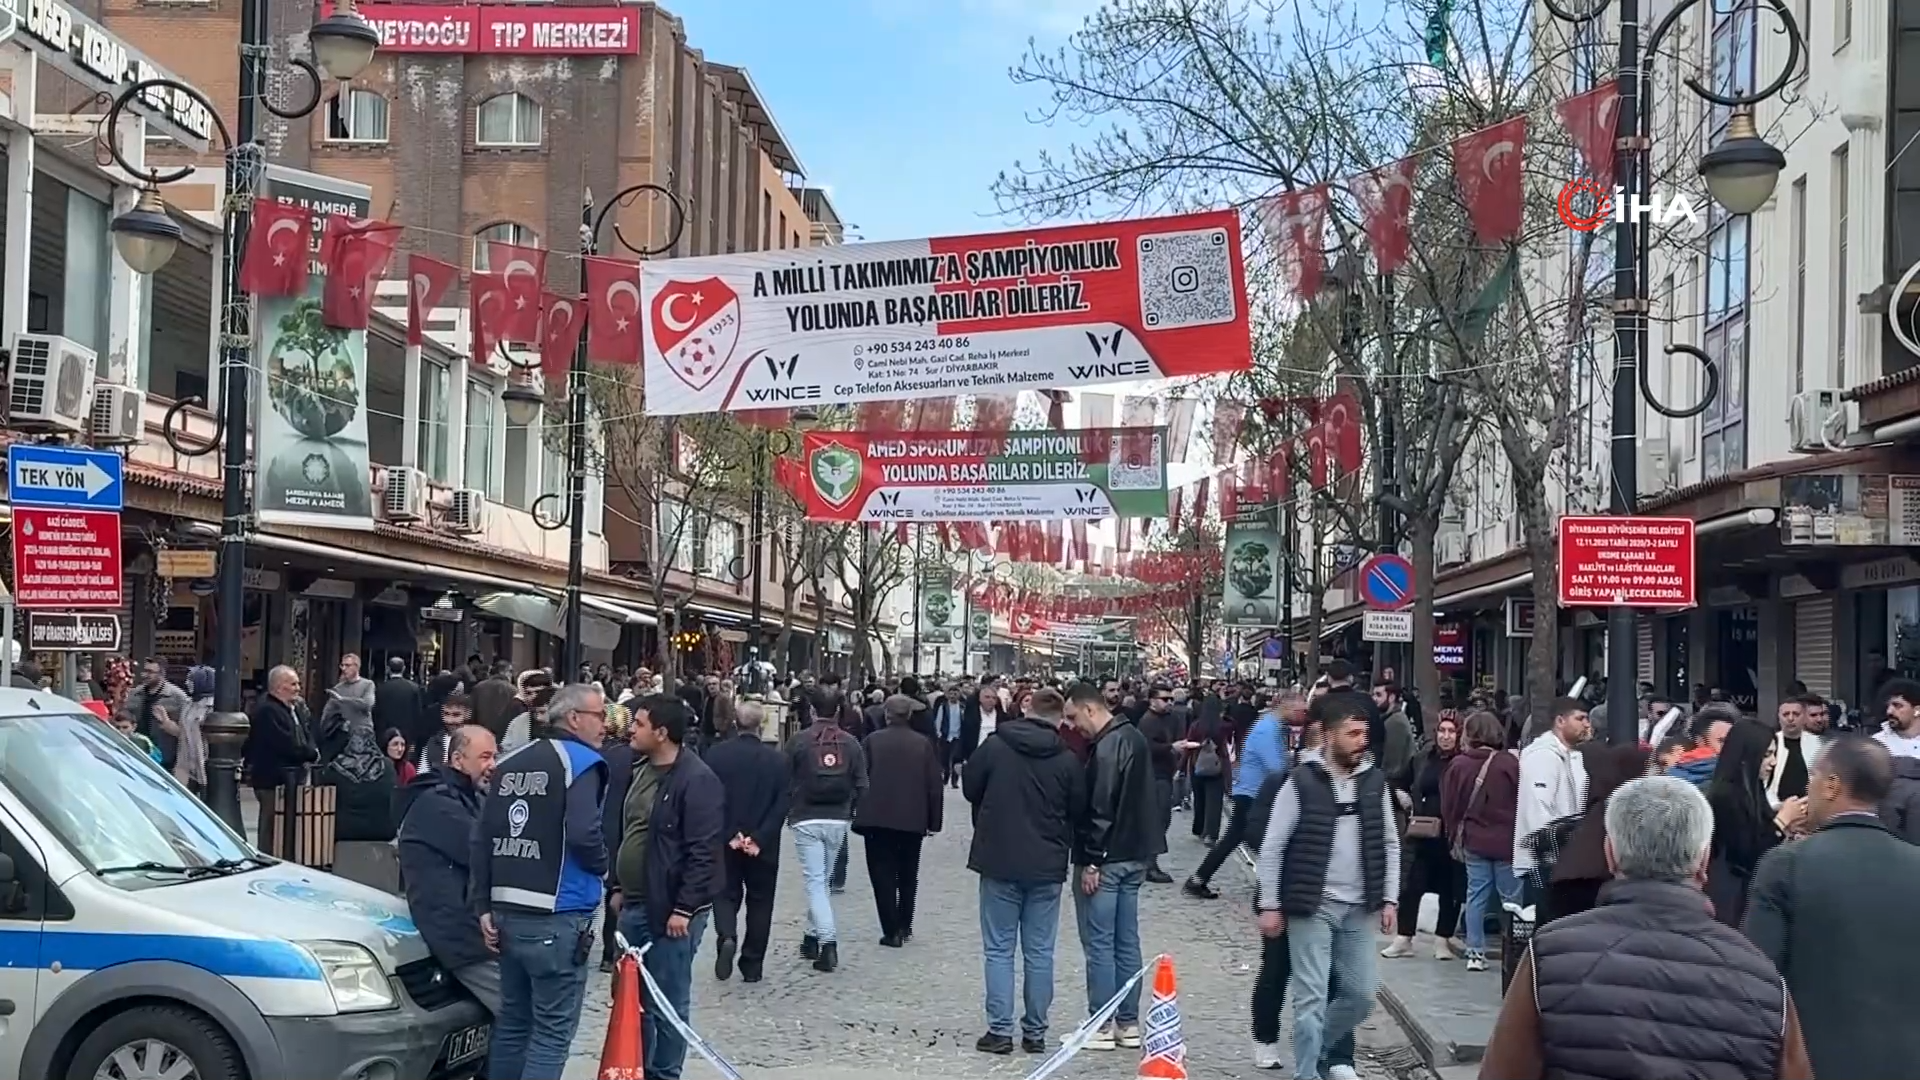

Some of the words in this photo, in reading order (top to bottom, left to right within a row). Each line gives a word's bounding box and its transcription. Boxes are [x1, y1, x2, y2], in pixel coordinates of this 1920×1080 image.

[491, 22, 526, 48] TIP
[532, 16, 628, 49] MERKEZİ
[312, 199, 357, 217] AMEDÊ
[753, 271, 769, 298] A
[773, 259, 827, 297] MİLLİ
[830, 254, 962, 293] TAKIMIMIZ'A
[966, 240, 1121, 286] ŞAMPİYONLUK
[786, 303, 881, 333] YOLUNDA
[886, 290, 1001, 326] BAŞARILAR
[1005, 274, 1089, 316] DİLERİZ.
[708, 313, 735, 336] 1923
[867, 343, 888, 355] +90
[891, 341, 912, 353] 534
[915, 339, 936, 351] 243
[938, 338, 953, 349] 40
[955, 336, 970, 347] 86
[909, 368, 919, 376] 74
[945, 361, 999, 374] DİYARBAKIR
[1068, 360, 1150, 379] WINCE
[746, 385, 821, 402] WINCE
[834, 385, 853, 398] Cep
[855, 381, 892, 395] Telefon
[894, 377, 956, 392] Aksesuarları
[957, 378, 970, 387] ve
[971, 373, 1005, 387] Teknik
[1007, 371, 1054, 384] Malzeme
[867, 440, 906, 458] AMED
[20, 467, 49, 487] TEK
[56, 466, 85, 489] YÖN
[881, 464, 947, 483] YOLUNDA
[950, 461, 1031, 484] BAŞARILAR
[1033, 458, 1090, 480] DİLERİZ.
[1063, 506, 1110, 517] WINCE
[1568, 523, 1607, 534] DİYARBAKIR
[1608, 523, 1647, 535] BÜYÜKŞEHİR
[1649, 525, 1685, 535] BELEDİYESİ
[1615, 562, 1642, 572] LOJİSTİK
[1571, 575, 1594, 584] SAAT
[1598, 575, 1620, 584] 19:00
[1621, 576, 1631, 584] ve
[1633, 576, 1656, 585] 09:00
[1656, 576, 1682, 585] ARASI
[1569, 586, 1592, 598] GİRİŞ
[1433, 645, 1464, 654] MERVE
[1433, 654, 1464, 665] DÖNER
[498, 771, 549, 796] SUR
